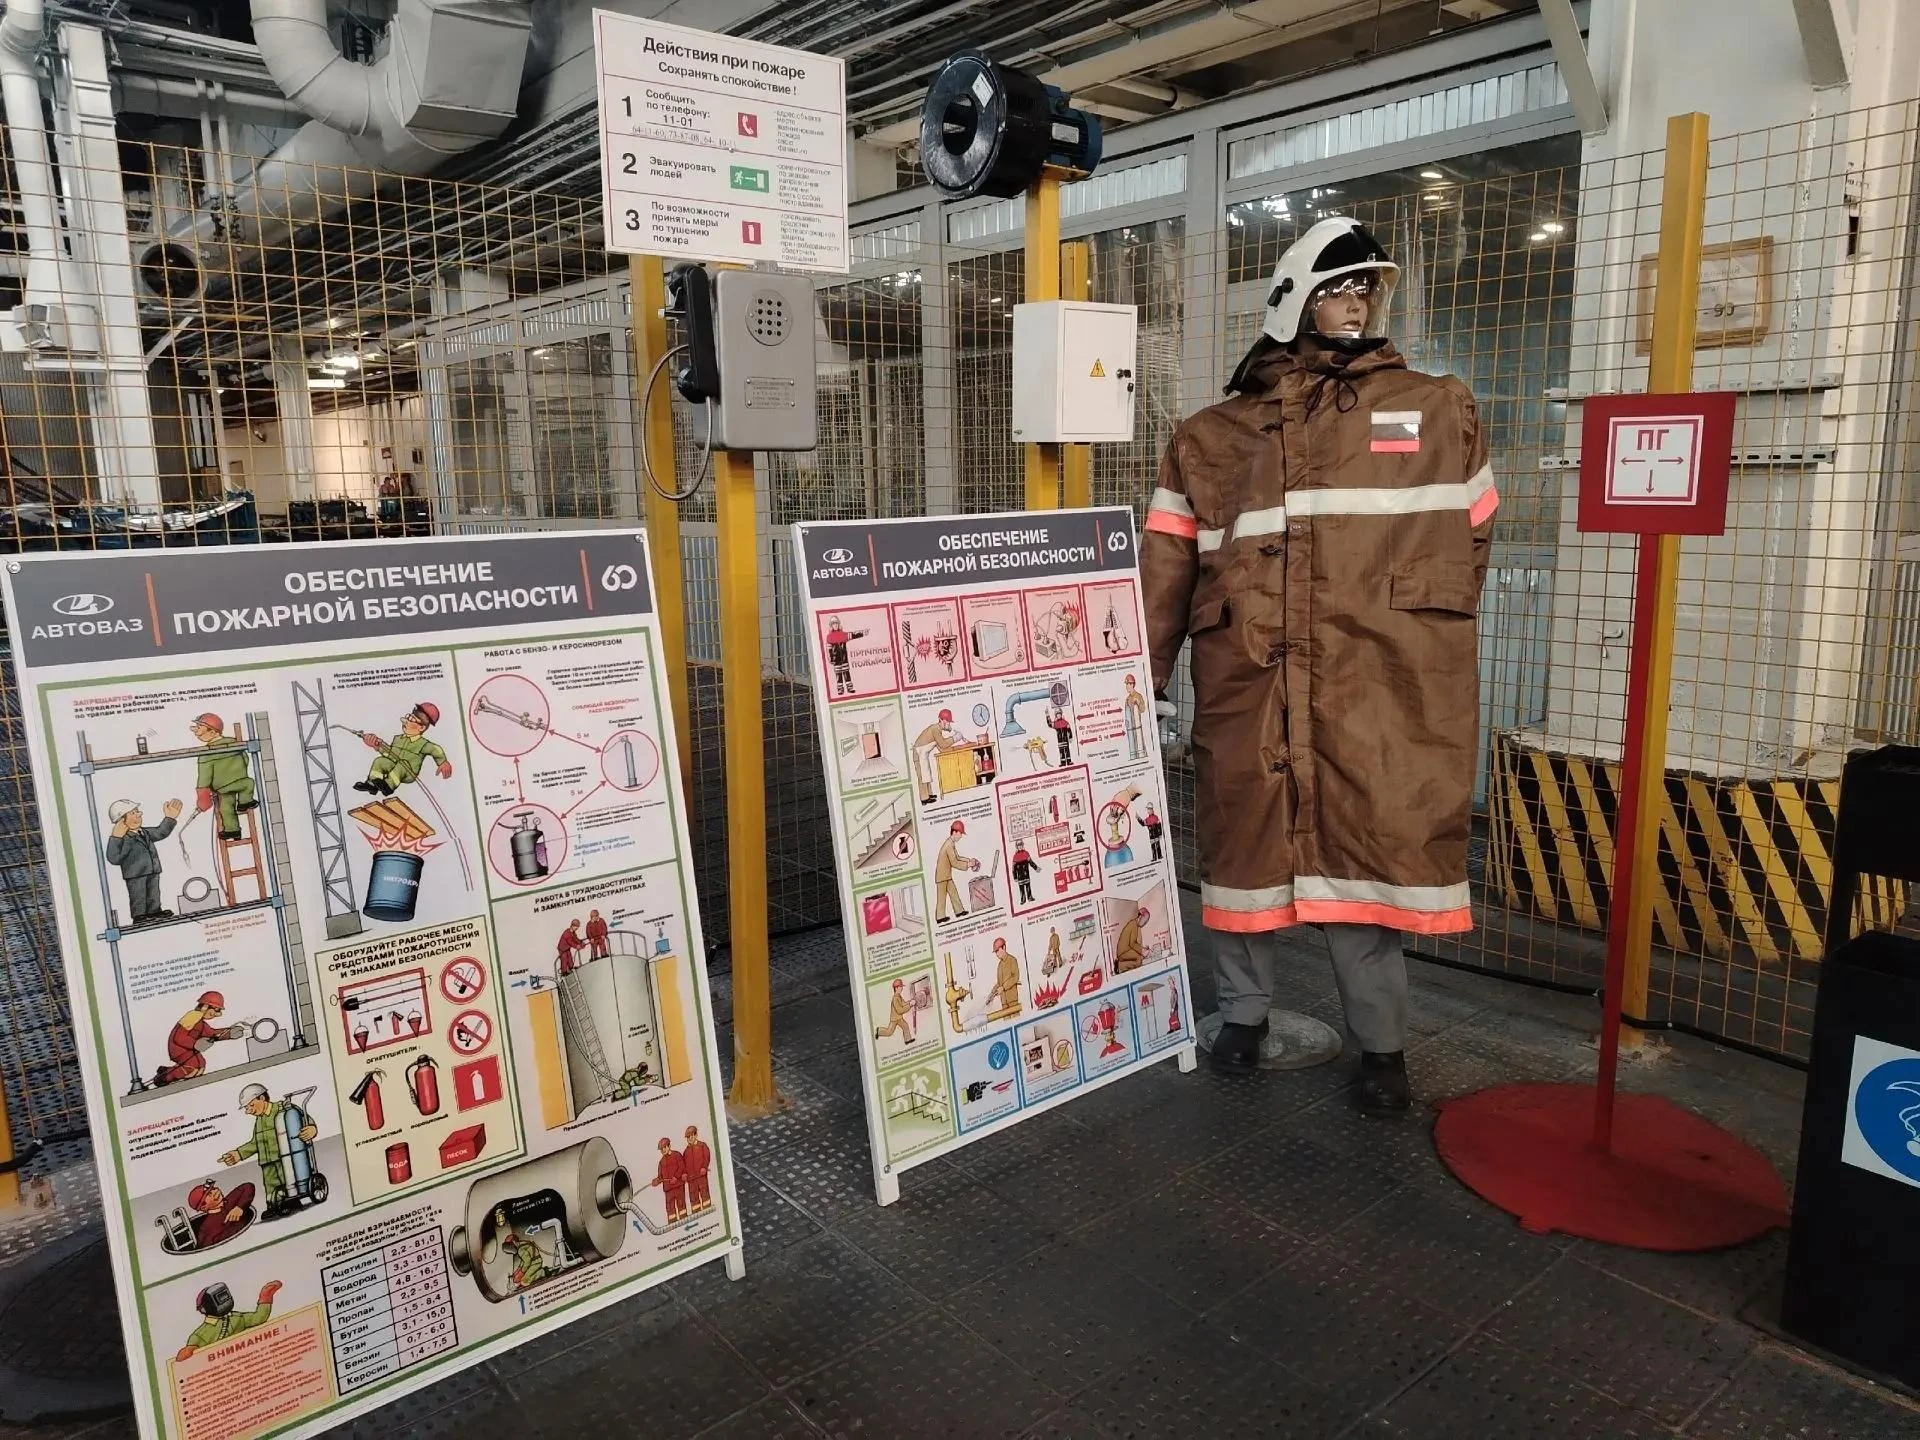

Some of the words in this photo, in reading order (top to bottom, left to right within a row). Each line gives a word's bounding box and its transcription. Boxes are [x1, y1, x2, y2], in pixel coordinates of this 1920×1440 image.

[643, 37, 718, 63] Действия
[722, 55, 748, 69] при
[752, 60, 805, 79] пожаре
[659, 62, 719, 81] Сохранять
[722, 74, 791, 93] спокойствие
[622, 96, 631, 117] 1
[646, 89, 695, 105] Сообщить
[647, 102, 658, 110] по
[661, 104, 710, 119] телефону:
[663, 115, 692, 127] 11-01
[622, 153, 637, 174] 2
[650, 157, 716, 173] Эвакуировать
[650, 169, 682, 179] людей
[626, 209, 640, 230] 3
[652, 201, 663, 211] По
[667, 204, 729, 218] возможности
[652, 214, 690, 224] принять
[693, 218, 718, 227] меры
[652, 224, 664, 232] по
[667, 226, 709, 236] тушению
[653, 235, 688, 245] пожара
[1636, 428, 1670, 450] ПГ
[939, 529, 1049, 551] ОБЕСПЕЧЕНИЕ
[812, 566, 868, 579] АВТОВАЗ
[882, 553, 976, 578] ПОЖАРНОЙ
[980, 546, 1094, 569] БЕЗОПАСНОСТИ
[284, 562, 494, 594] ОБЕСПЕЧЕНИЕ
[173, 597, 363, 635] ПОЖАРНОЙ
[364, 585, 578, 620] БЕЗОПАСНОСТИ
[31, 618, 144, 640] АВТОВАЗ
[559, 639, 622, 650] КЕРОСИНОРЕЗОМ
[535, 893, 564, 904] РАБОТА
[572, 875, 642, 895] ТРУДНОДОСТУПНЫХ
[541, 897, 585, 912] ЗАМКНУТЫХ
[587, 882, 646, 901] ПРОСТРАНСТВАХ
[329, 950, 394, 971] СРЕДСТВАМИ
[397, 931, 479, 956] ПОЖАРОТУШЕНИЯ
[333, 940, 397, 961] ОБОРУДУЙТЕ
[399, 931, 440, 946] РАБОЧЕЕ
[442, 923, 473, 936] МЕСТО
[350, 960, 395, 975] ЗНАКАМИ
[399, 941, 471, 964] БЕЗОПАСНОСТИ
[367, 1046, 417, 1064] ОГНЕТУШИТЕЛИ
[128, 1115, 184, 1136] ЗАПРЕЩАЕТСЯ
[326, 1229, 365, 1247] ПРЕДЕЛЫ
[368, 1205, 432, 1232] ВЗРЫВАЕМОСТИ
[316, 1250, 331, 1258] при
[333, 1230, 384, 1251] содержании
[331, 1257, 378, 1279] Ацетилен
[391, 1245, 406, 1256] 2,2
[415, 1235, 435, 1247] 81,0
[334, 1274, 377, 1294] Водород
[393, 1258, 408, 1271] 3,3
[417, 1249, 437, 1262] 81,5
[336, 1293, 367, 1309] Метан
[396, 1275, 411, 1286] 4,8
[421, 1263, 439, 1276] 16,7
[338, 1306, 375, 1324] Пропан
[401, 1288, 416, 1299] 2,2
[424, 1279, 439, 1291] 9,5
[340, 1324, 368, 1340] Бутан
[404, 1304, 418, 1314] 1,5
[343, 1341, 366, 1355] Этан
[402, 1319, 416, 1330] 3,1
[426, 1306, 446, 1320] 15,0
[208, 1328, 280, 1362] ВНИМАНИЕ
[345, 1351, 380, 1370] Бензин
[407, 1332, 421, 1344] 0,7
[431, 1322, 445, 1334] 6,0
[347, 1364, 388, 1385] Керосин
[411, 1346, 424, 1358] 1,4
[433, 1337, 447, 1348] 7,5
